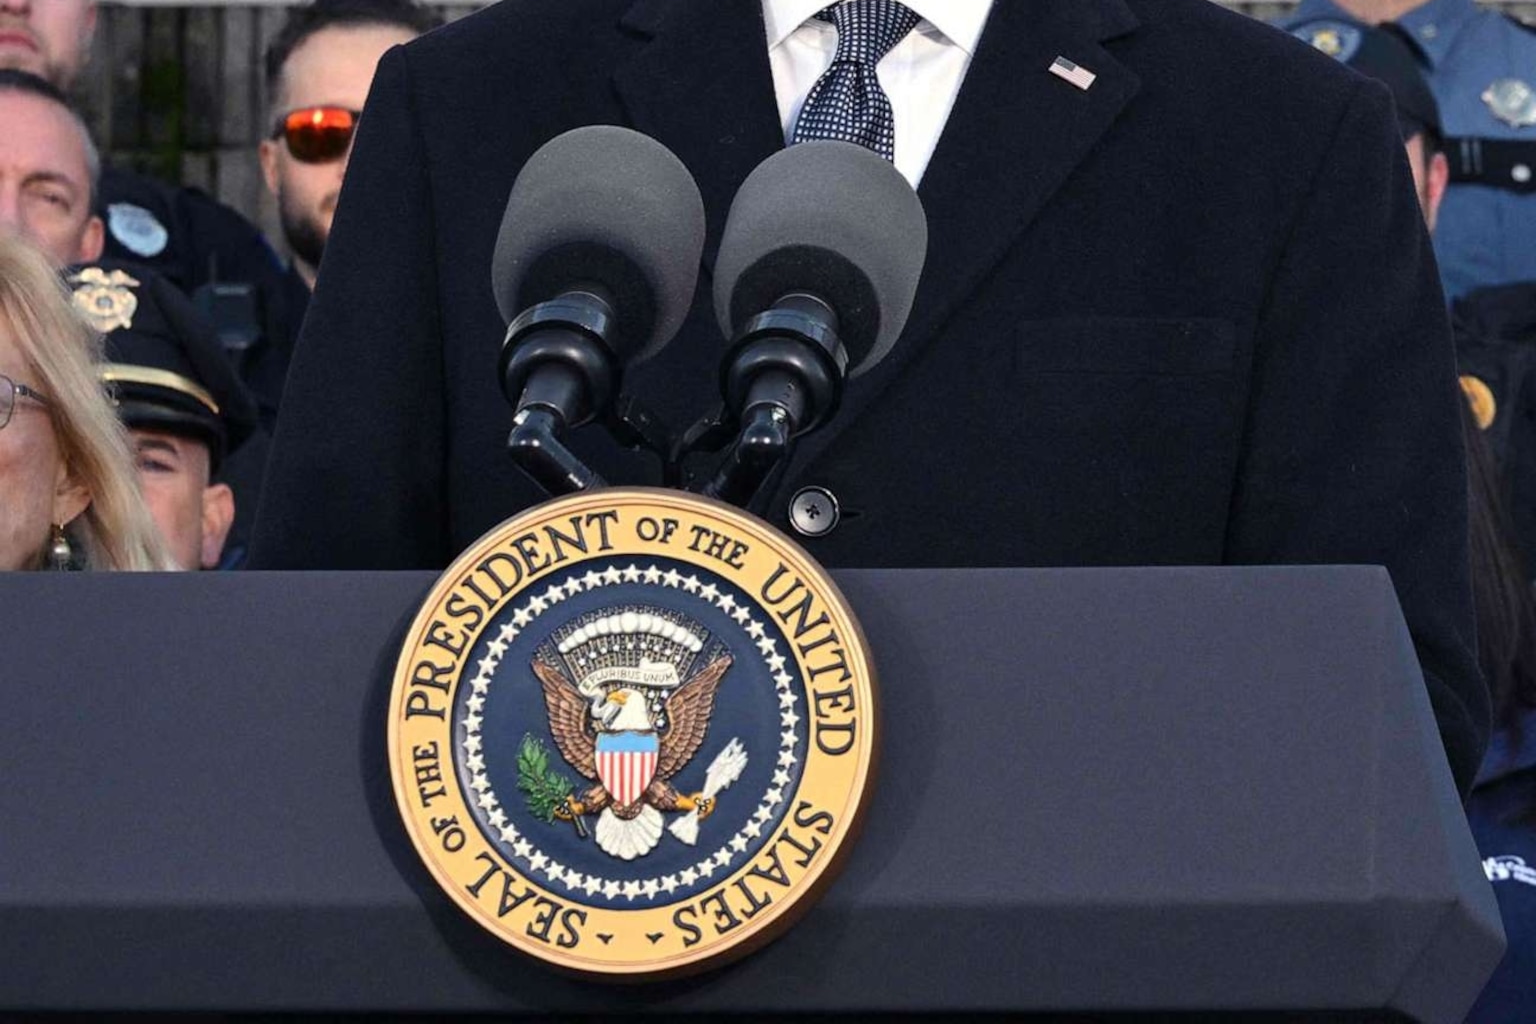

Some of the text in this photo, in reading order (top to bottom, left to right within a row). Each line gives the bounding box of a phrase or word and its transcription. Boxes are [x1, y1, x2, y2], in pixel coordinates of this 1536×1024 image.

[405, 509, 857, 950] SEAL OF THE PRESIDENT OF THE UNITED STATES
